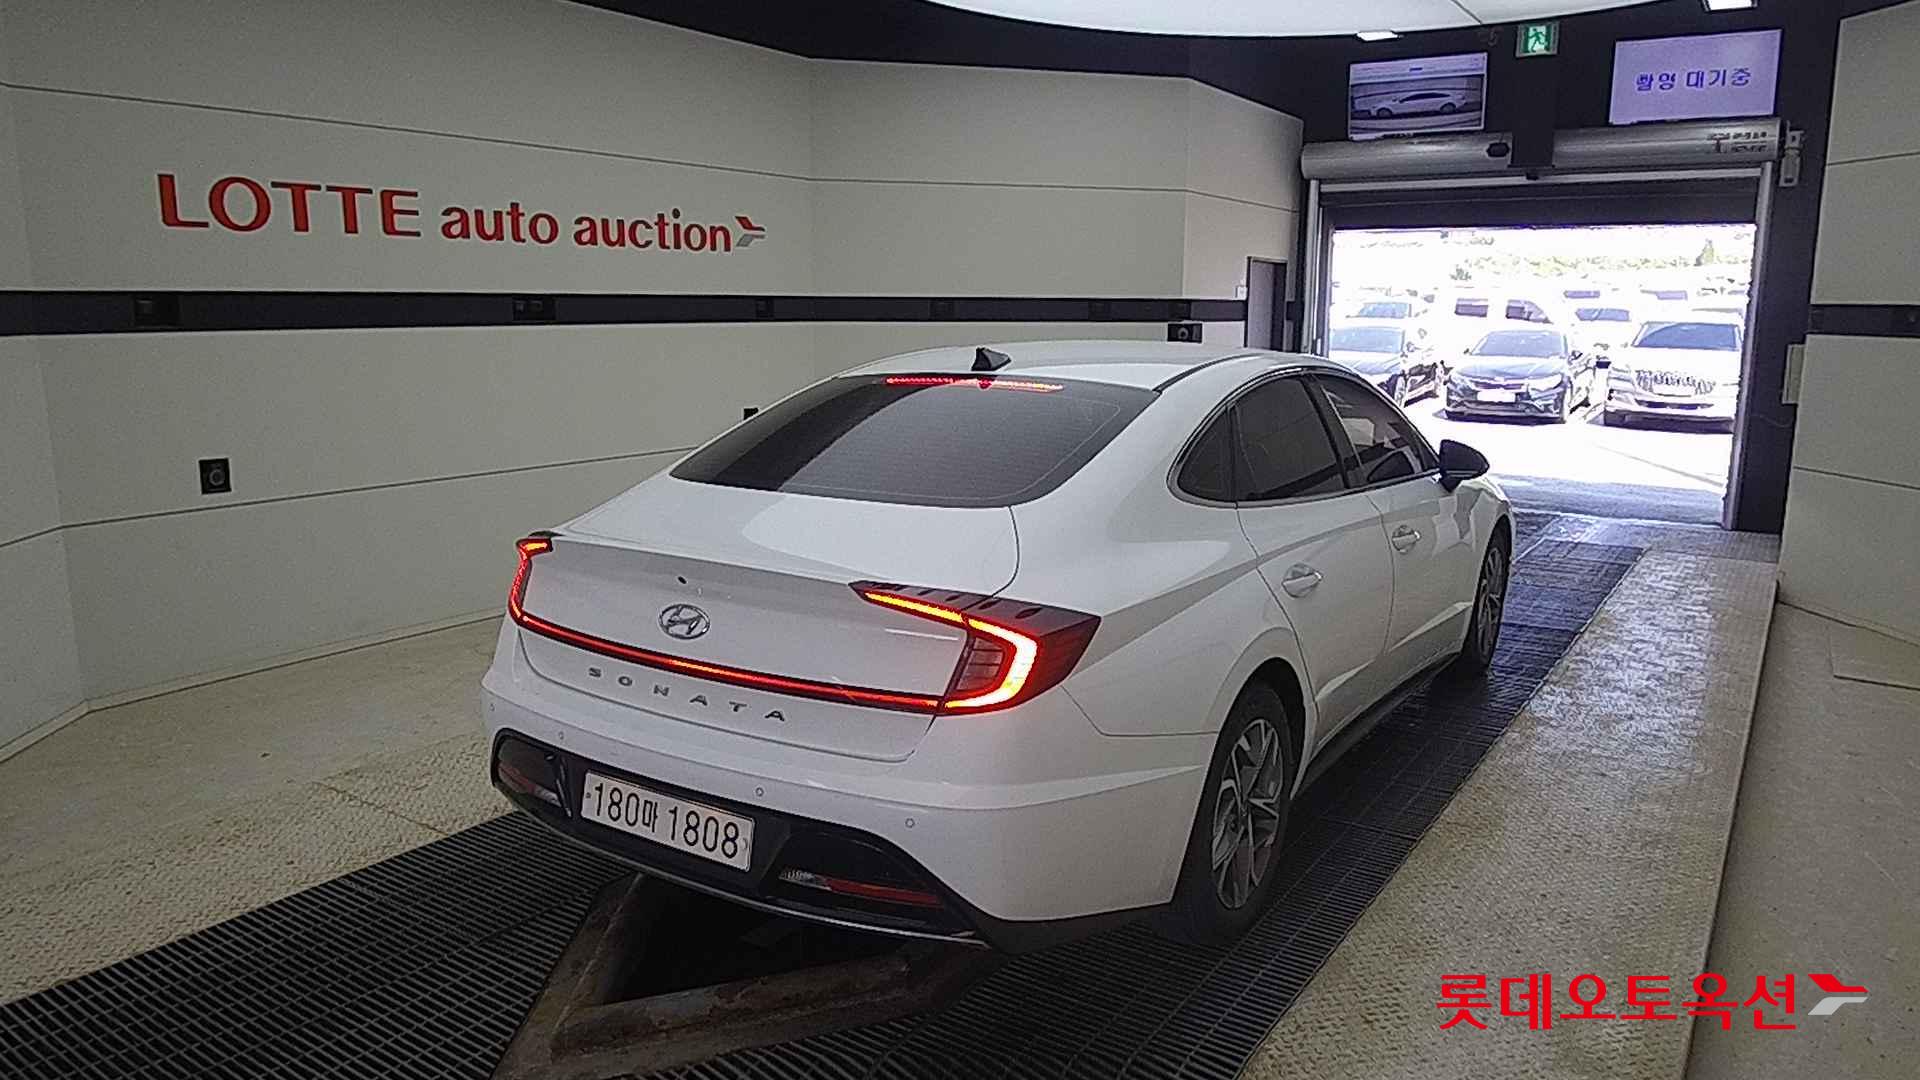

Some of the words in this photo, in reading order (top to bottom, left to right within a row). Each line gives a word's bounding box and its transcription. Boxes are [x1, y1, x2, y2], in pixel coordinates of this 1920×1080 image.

[1686, 68, 1751, 88] 대기중
[156, 173, 422, 238] LOTTE
[440, 202, 560, 245] auto
[573, 207, 732, 253] auction
[588, 666, 785, 722] SONATA
[594, 782, 659, 833] 180마
[668, 805, 740, 859] 1808
